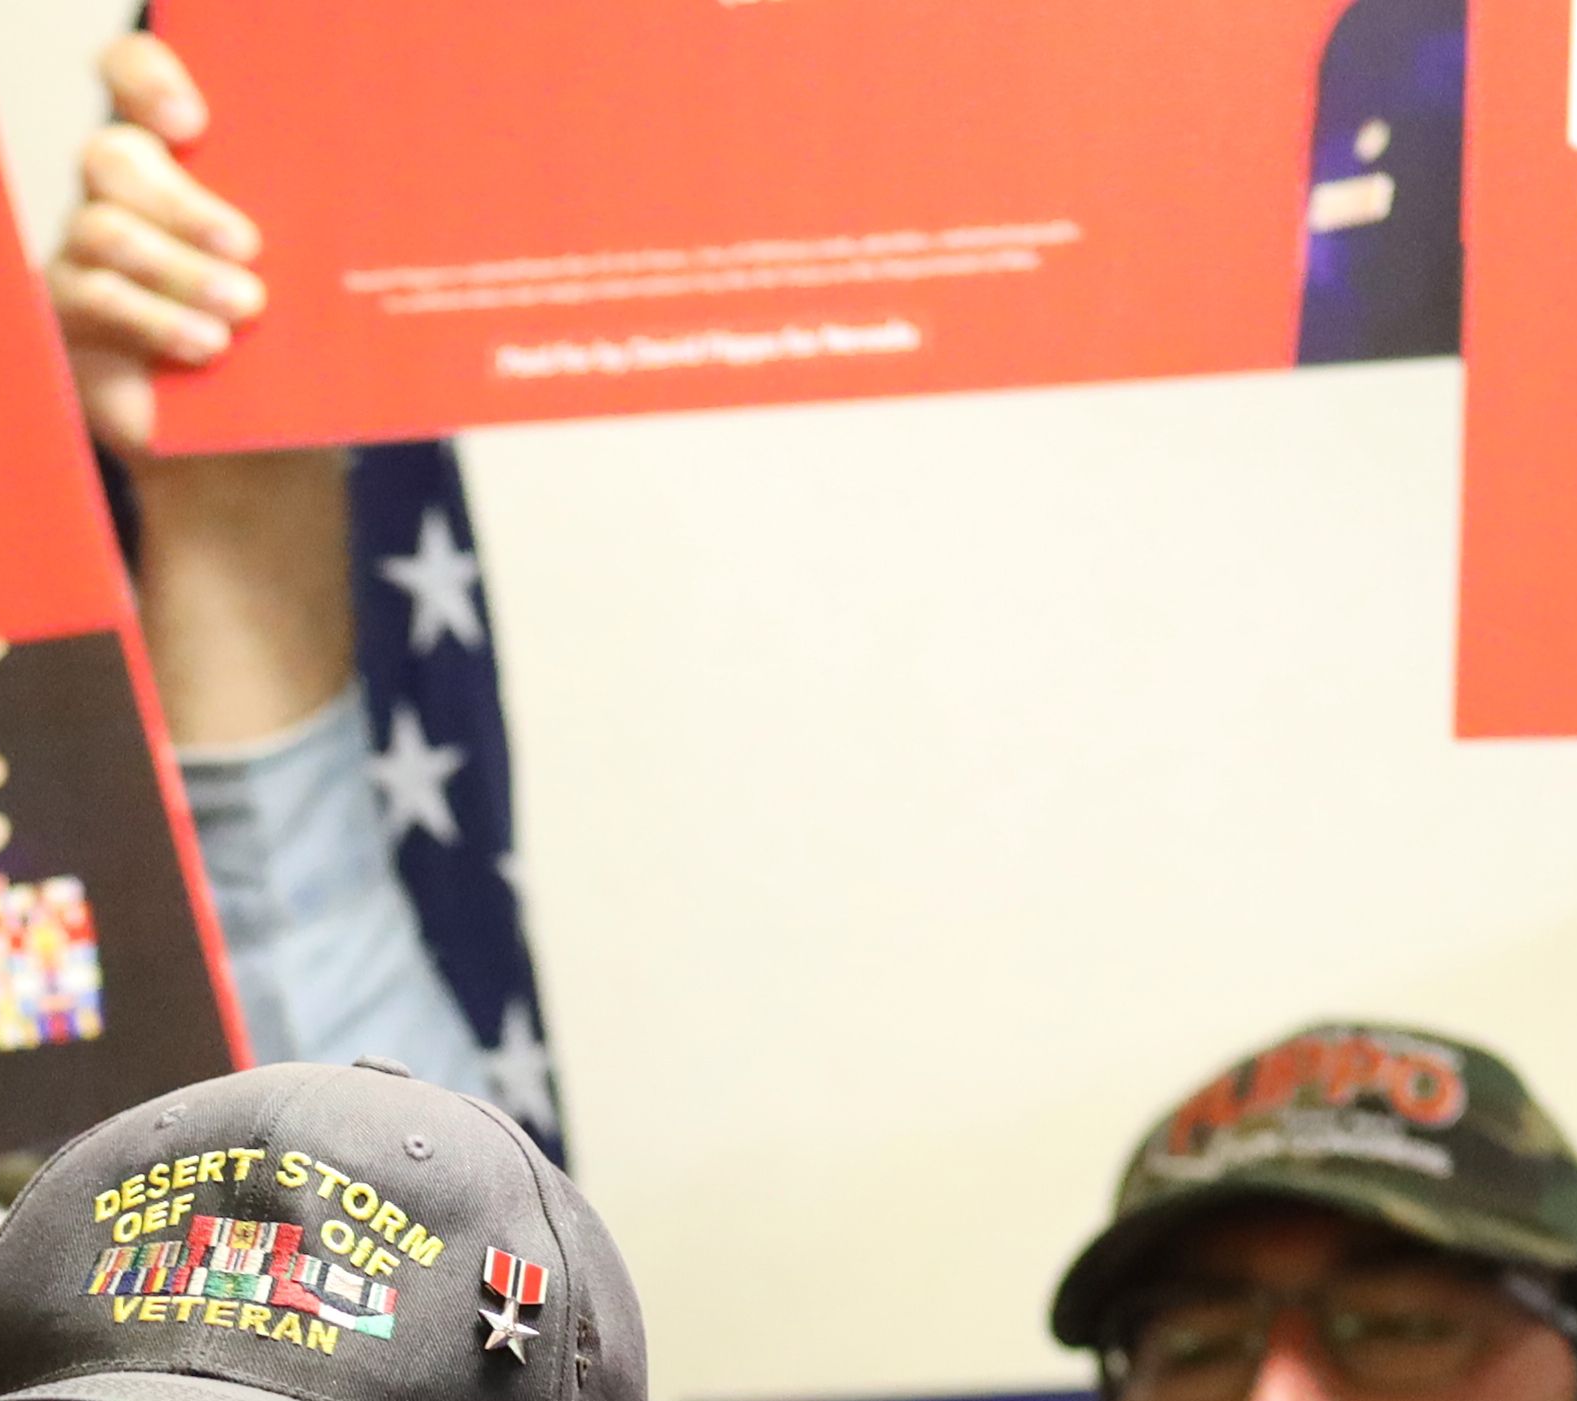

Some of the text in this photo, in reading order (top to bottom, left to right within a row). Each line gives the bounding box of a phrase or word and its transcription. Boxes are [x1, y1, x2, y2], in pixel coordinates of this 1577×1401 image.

[94, 1147, 446, 1268] DESERT STORM
[112, 1193, 401, 1278] OEF OIF
[112, 1295, 341, 1356] VETERAN
